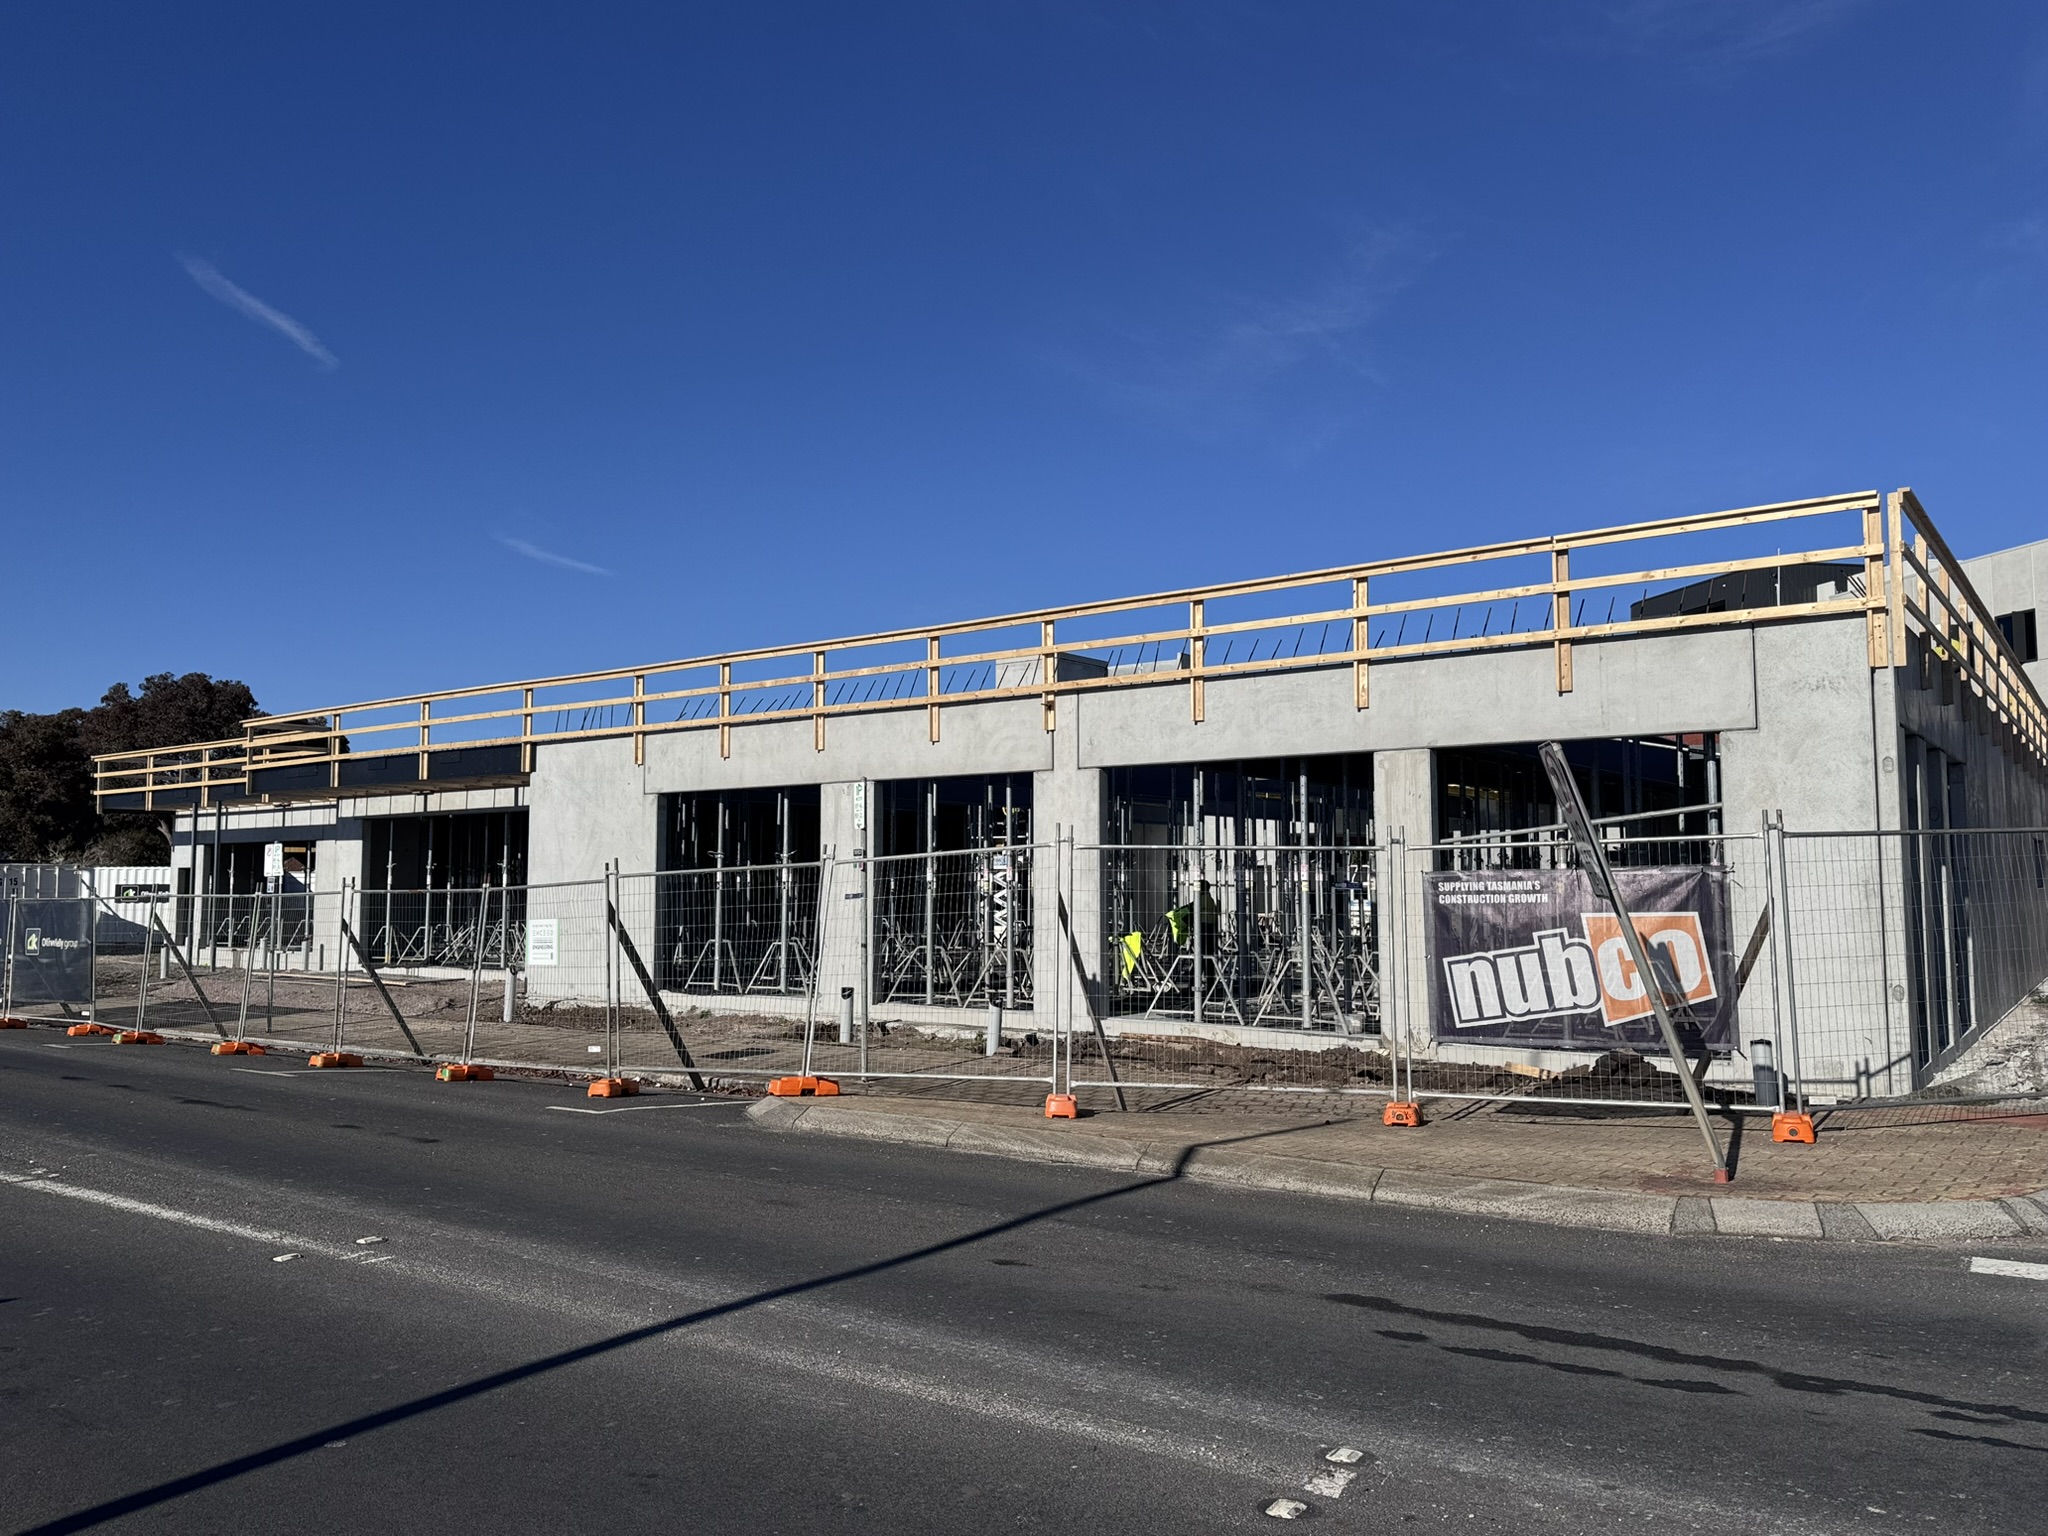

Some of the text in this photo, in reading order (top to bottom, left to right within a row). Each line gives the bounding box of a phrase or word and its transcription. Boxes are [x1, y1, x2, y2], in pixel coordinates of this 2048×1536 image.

[9, 877, 18, 886] 15
[1438, 880, 1541, 892] SUPPLYING TASMANIA'S
[1438, 893, 1549, 904] CONSTRUCTION GROWTH
[1449, 928, 1704, 1023] nubco
